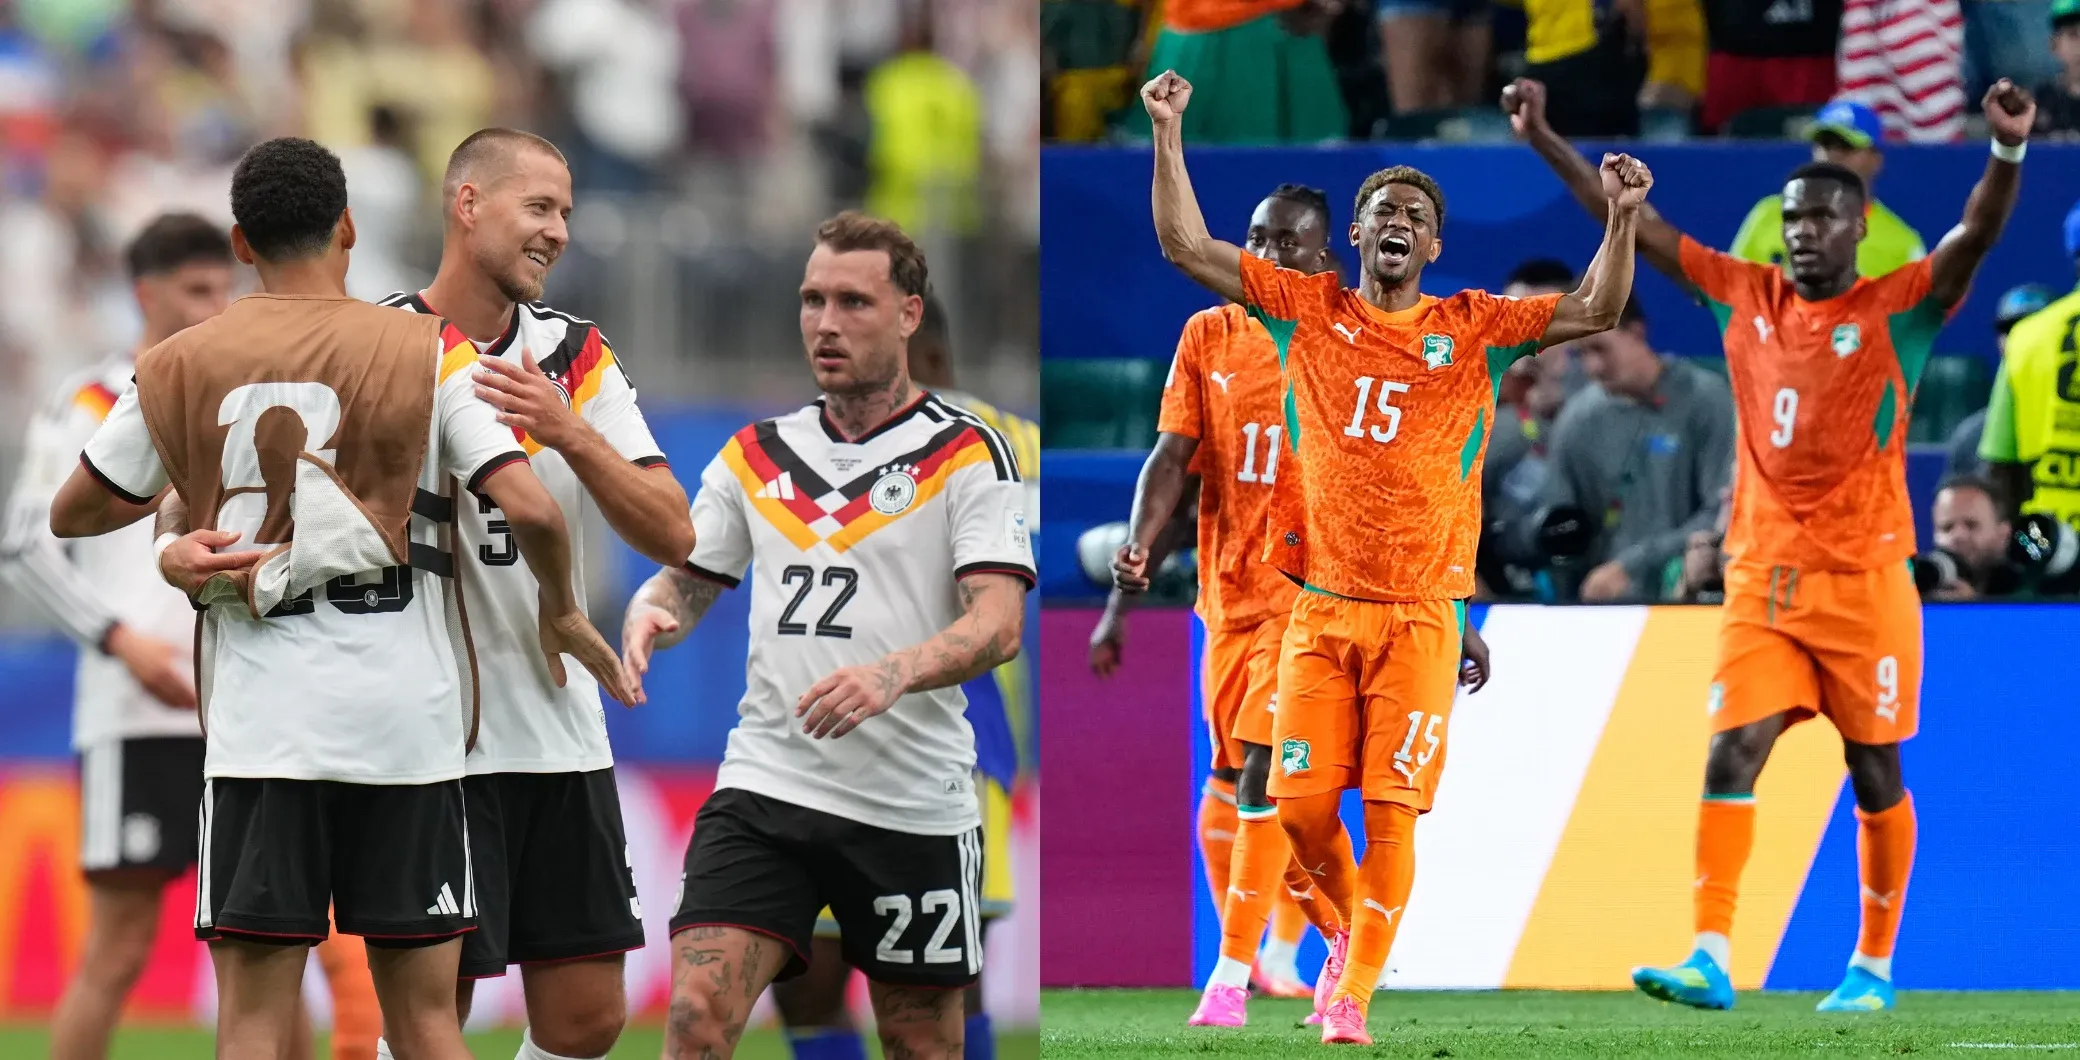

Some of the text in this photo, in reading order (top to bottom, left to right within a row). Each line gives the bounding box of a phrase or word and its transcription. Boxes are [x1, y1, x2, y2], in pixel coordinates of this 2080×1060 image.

[1344, 376, 1411, 443] 15
[1770, 387, 1799, 449] 9
[1237, 422, 1282, 485] 11
[777, 565, 859, 639] 22
[1876, 655, 1898, 705] 9
[1393, 711, 1443, 767] 15
[873, 888, 962, 964] 22
